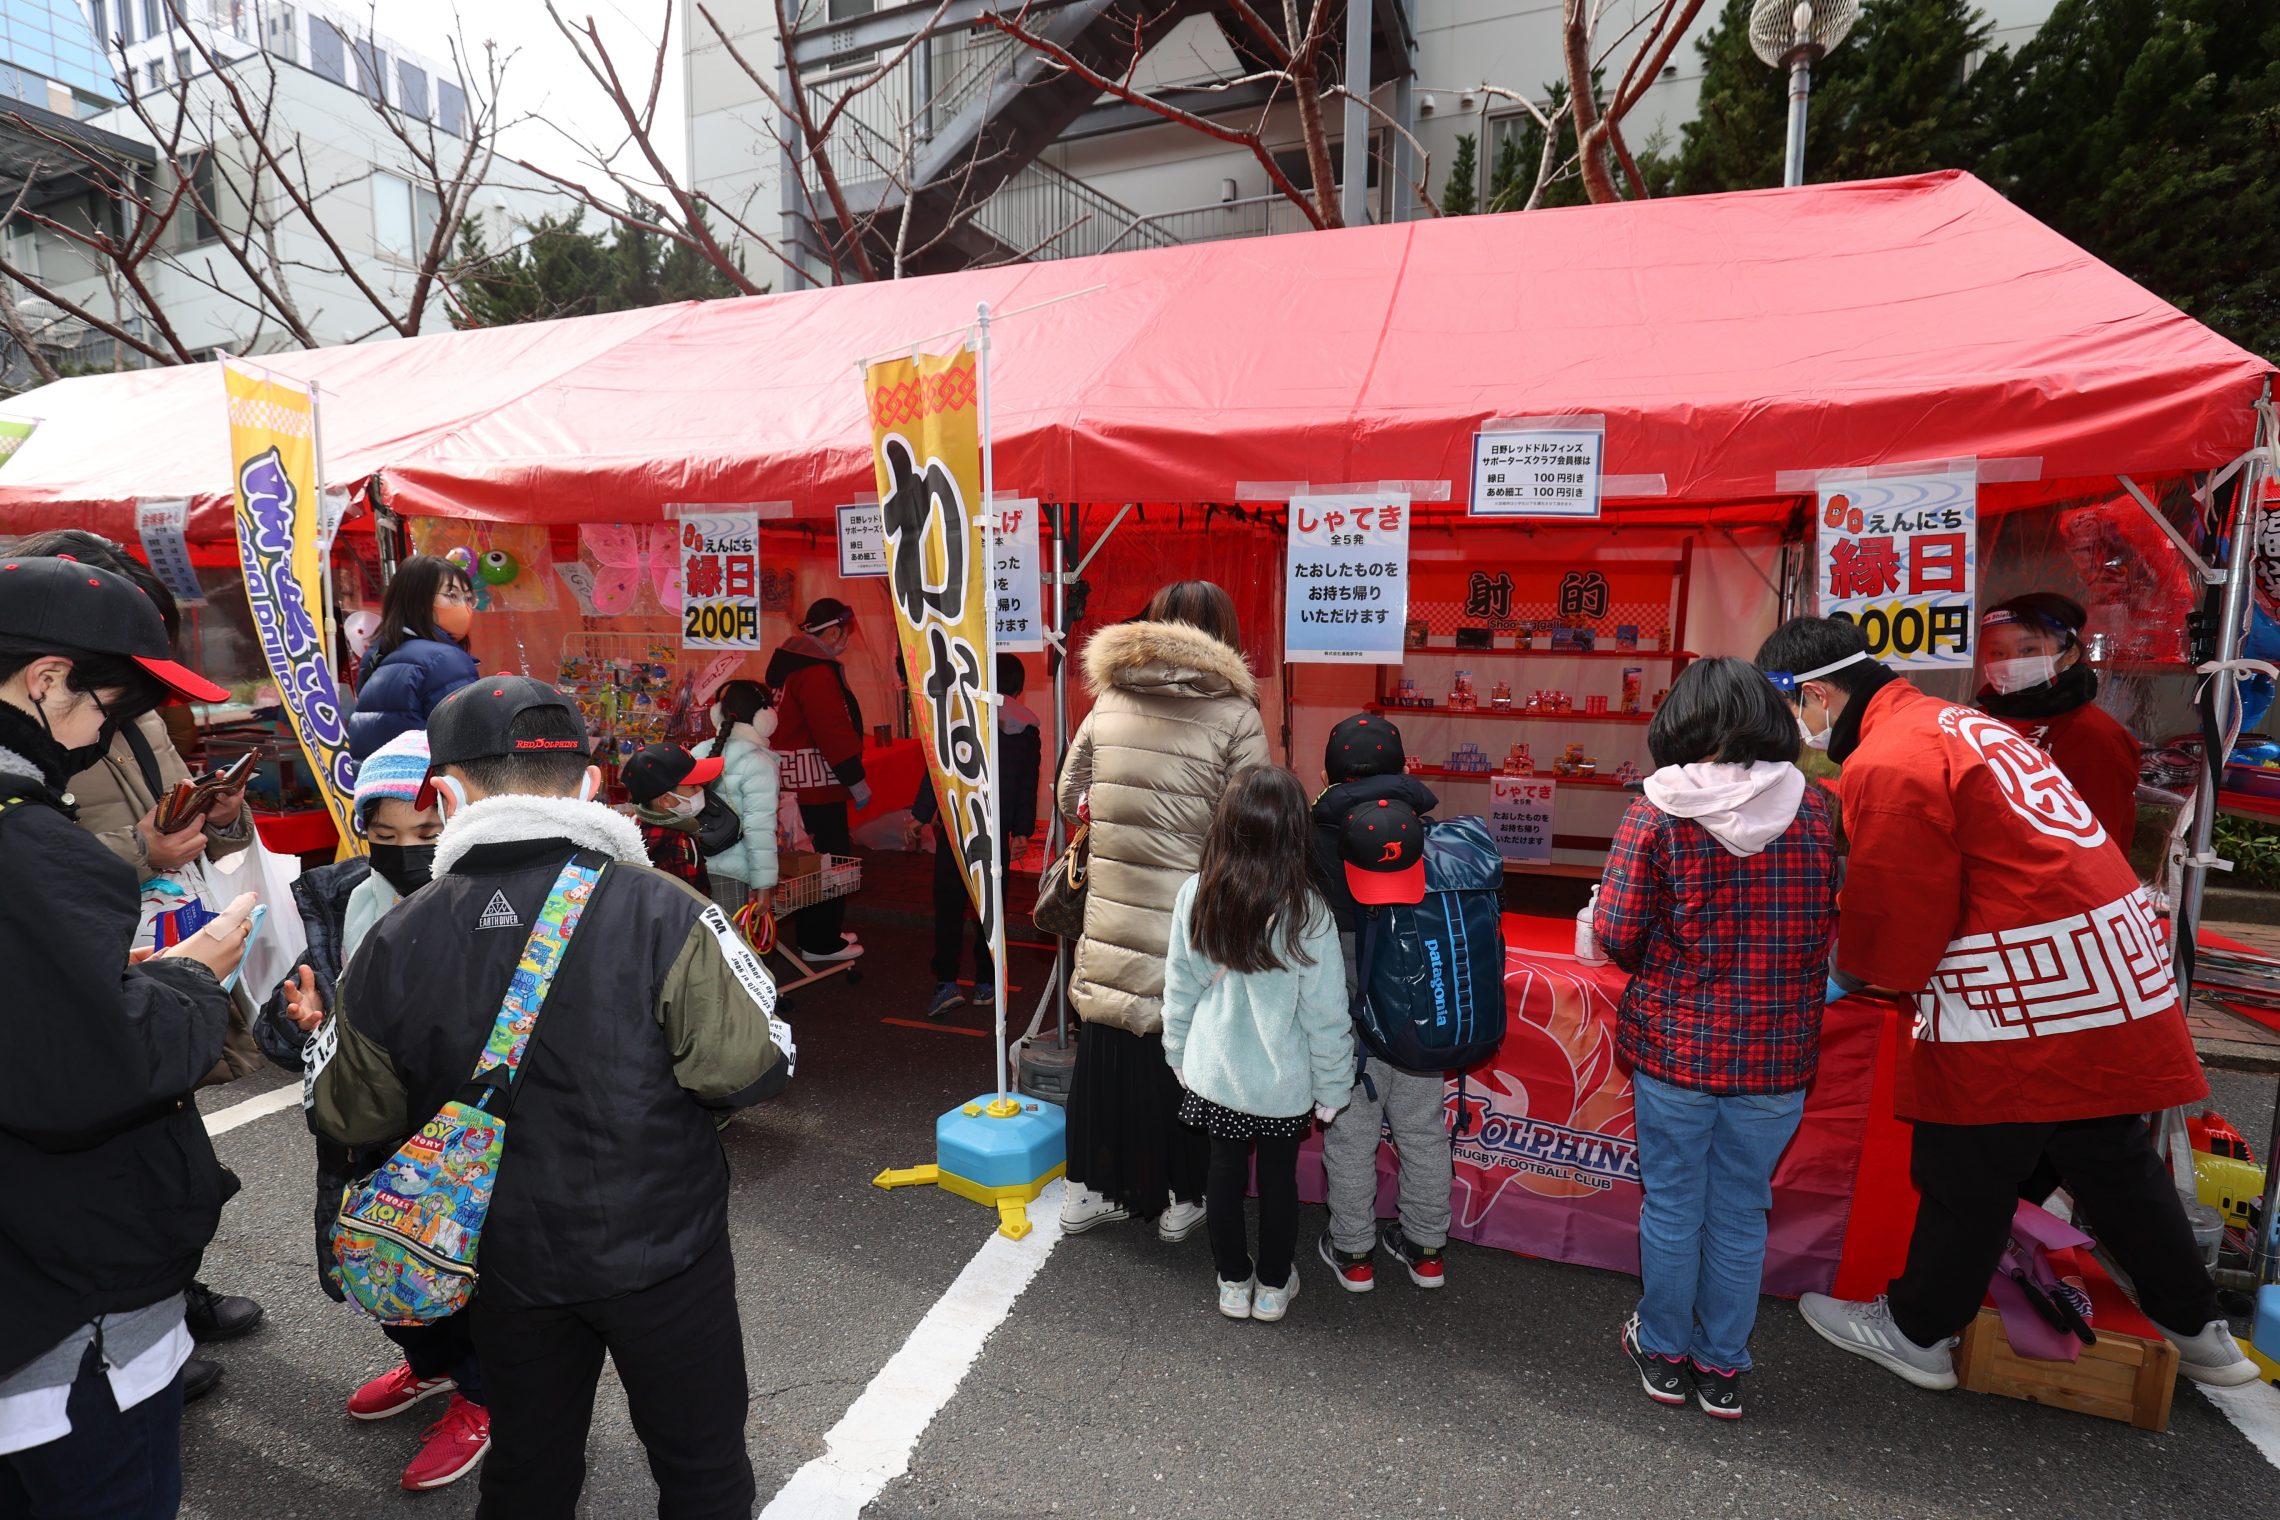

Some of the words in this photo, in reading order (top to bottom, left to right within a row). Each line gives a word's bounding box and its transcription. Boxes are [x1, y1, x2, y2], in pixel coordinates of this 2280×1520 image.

[1491, 443, 1584, 455] 日野レッドドルフィンズ
[1482, 455, 1591, 466] サポーターズクラブ会員様は
[1487, 474, 1505, 483] 縁日
[1486, 487, 1523, 497] あめ細工
[850, 514, 883, 525] 日野レッド
[1297, 505, 1402, 534] しゃてき
[1868, 509, 1962, 534] えんにち
[705, 538, 752, 553] えんにち
[1331, 534, 1364, 546] 全5発
[1295, 562, 1398, 578] たおしたものを
[1830, 532, 1966, 599] 縁日
[686, 554, 755, 598] 縁日
[1308, 585, 1381, 601] お持ち帰り
[685, 605, 757, 640] 200円
[1301, 608, 1389, 624] いただけます
[1828, 605, 1969, 655] 00円
[1495, 783, 1551, 799] しゃてき
[1493, 812, 1549, 822] たおしたものを
[1500, 824, 1540, 833] お持ち帰り
[1496, 835, 1543, 845] いただけます
[1424, 939, 1448, 1027] patagonia
[422, 1120, 455, 1140] OY
[1454, 1149, 1498, 1165] RUGBY
[1500, 1157, 1571, 1180] FOOTBALL
[1574, 1171, 1613, 1190] CLUB
